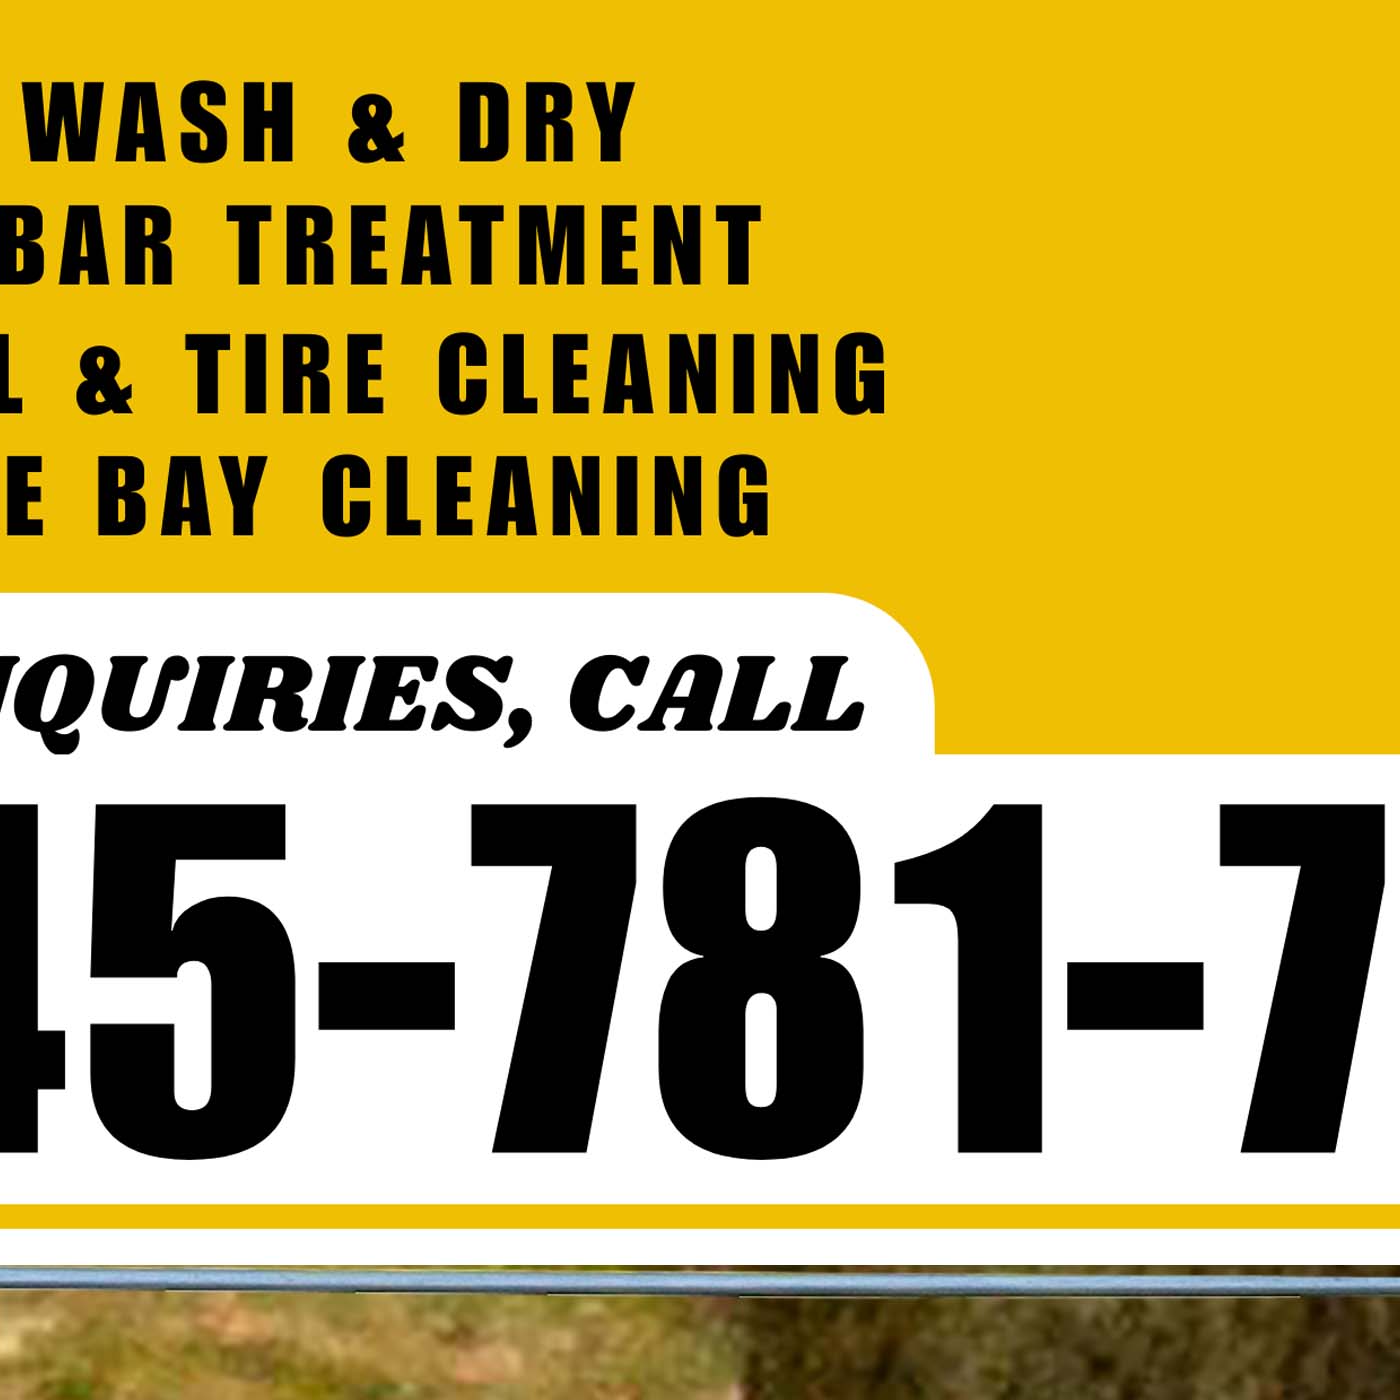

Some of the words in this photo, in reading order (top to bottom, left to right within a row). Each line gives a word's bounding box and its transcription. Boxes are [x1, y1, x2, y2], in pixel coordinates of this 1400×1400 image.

[21, 80, 293, 164] WASH
[348, 93, 405, 163] &
[459, 81, 635, 162] DRY
[226, 205, 761, 285] TREATMENT
[76, 345, 133, 415] &
[185, 333, 384, 414] TIRE
[438, 332, 885, 415] CLEANING
[98, 455, 268, 536] BAY
[322, 454, 768, 537] CLEANING
[569, 654, 865, 732] CALL
